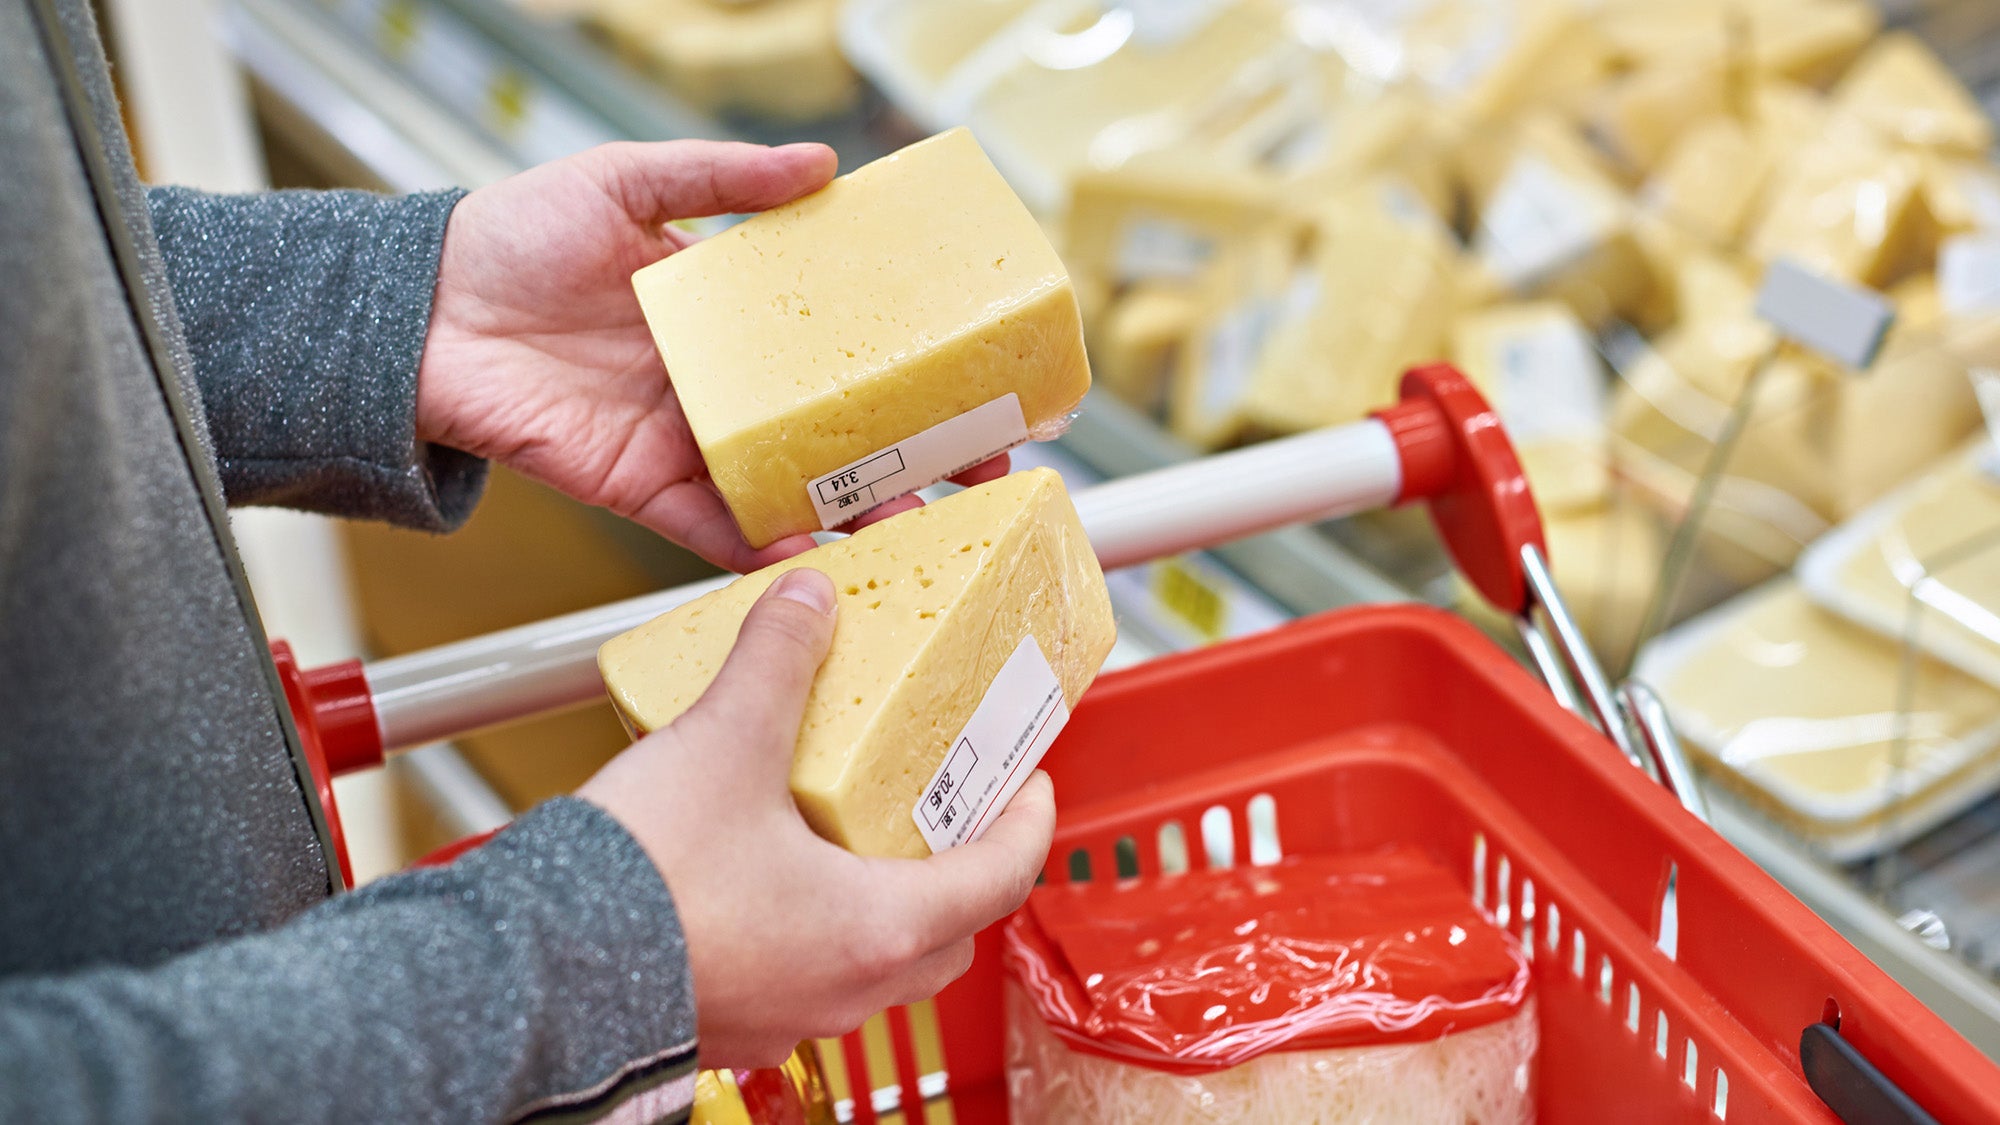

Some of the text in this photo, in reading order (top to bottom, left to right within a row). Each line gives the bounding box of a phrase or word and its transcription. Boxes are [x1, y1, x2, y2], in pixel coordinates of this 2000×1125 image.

[831, 471, 859, 492] 3.14
[837, 493, 860, 509] 0.362
[929, 771, 955, 812] 20.45
